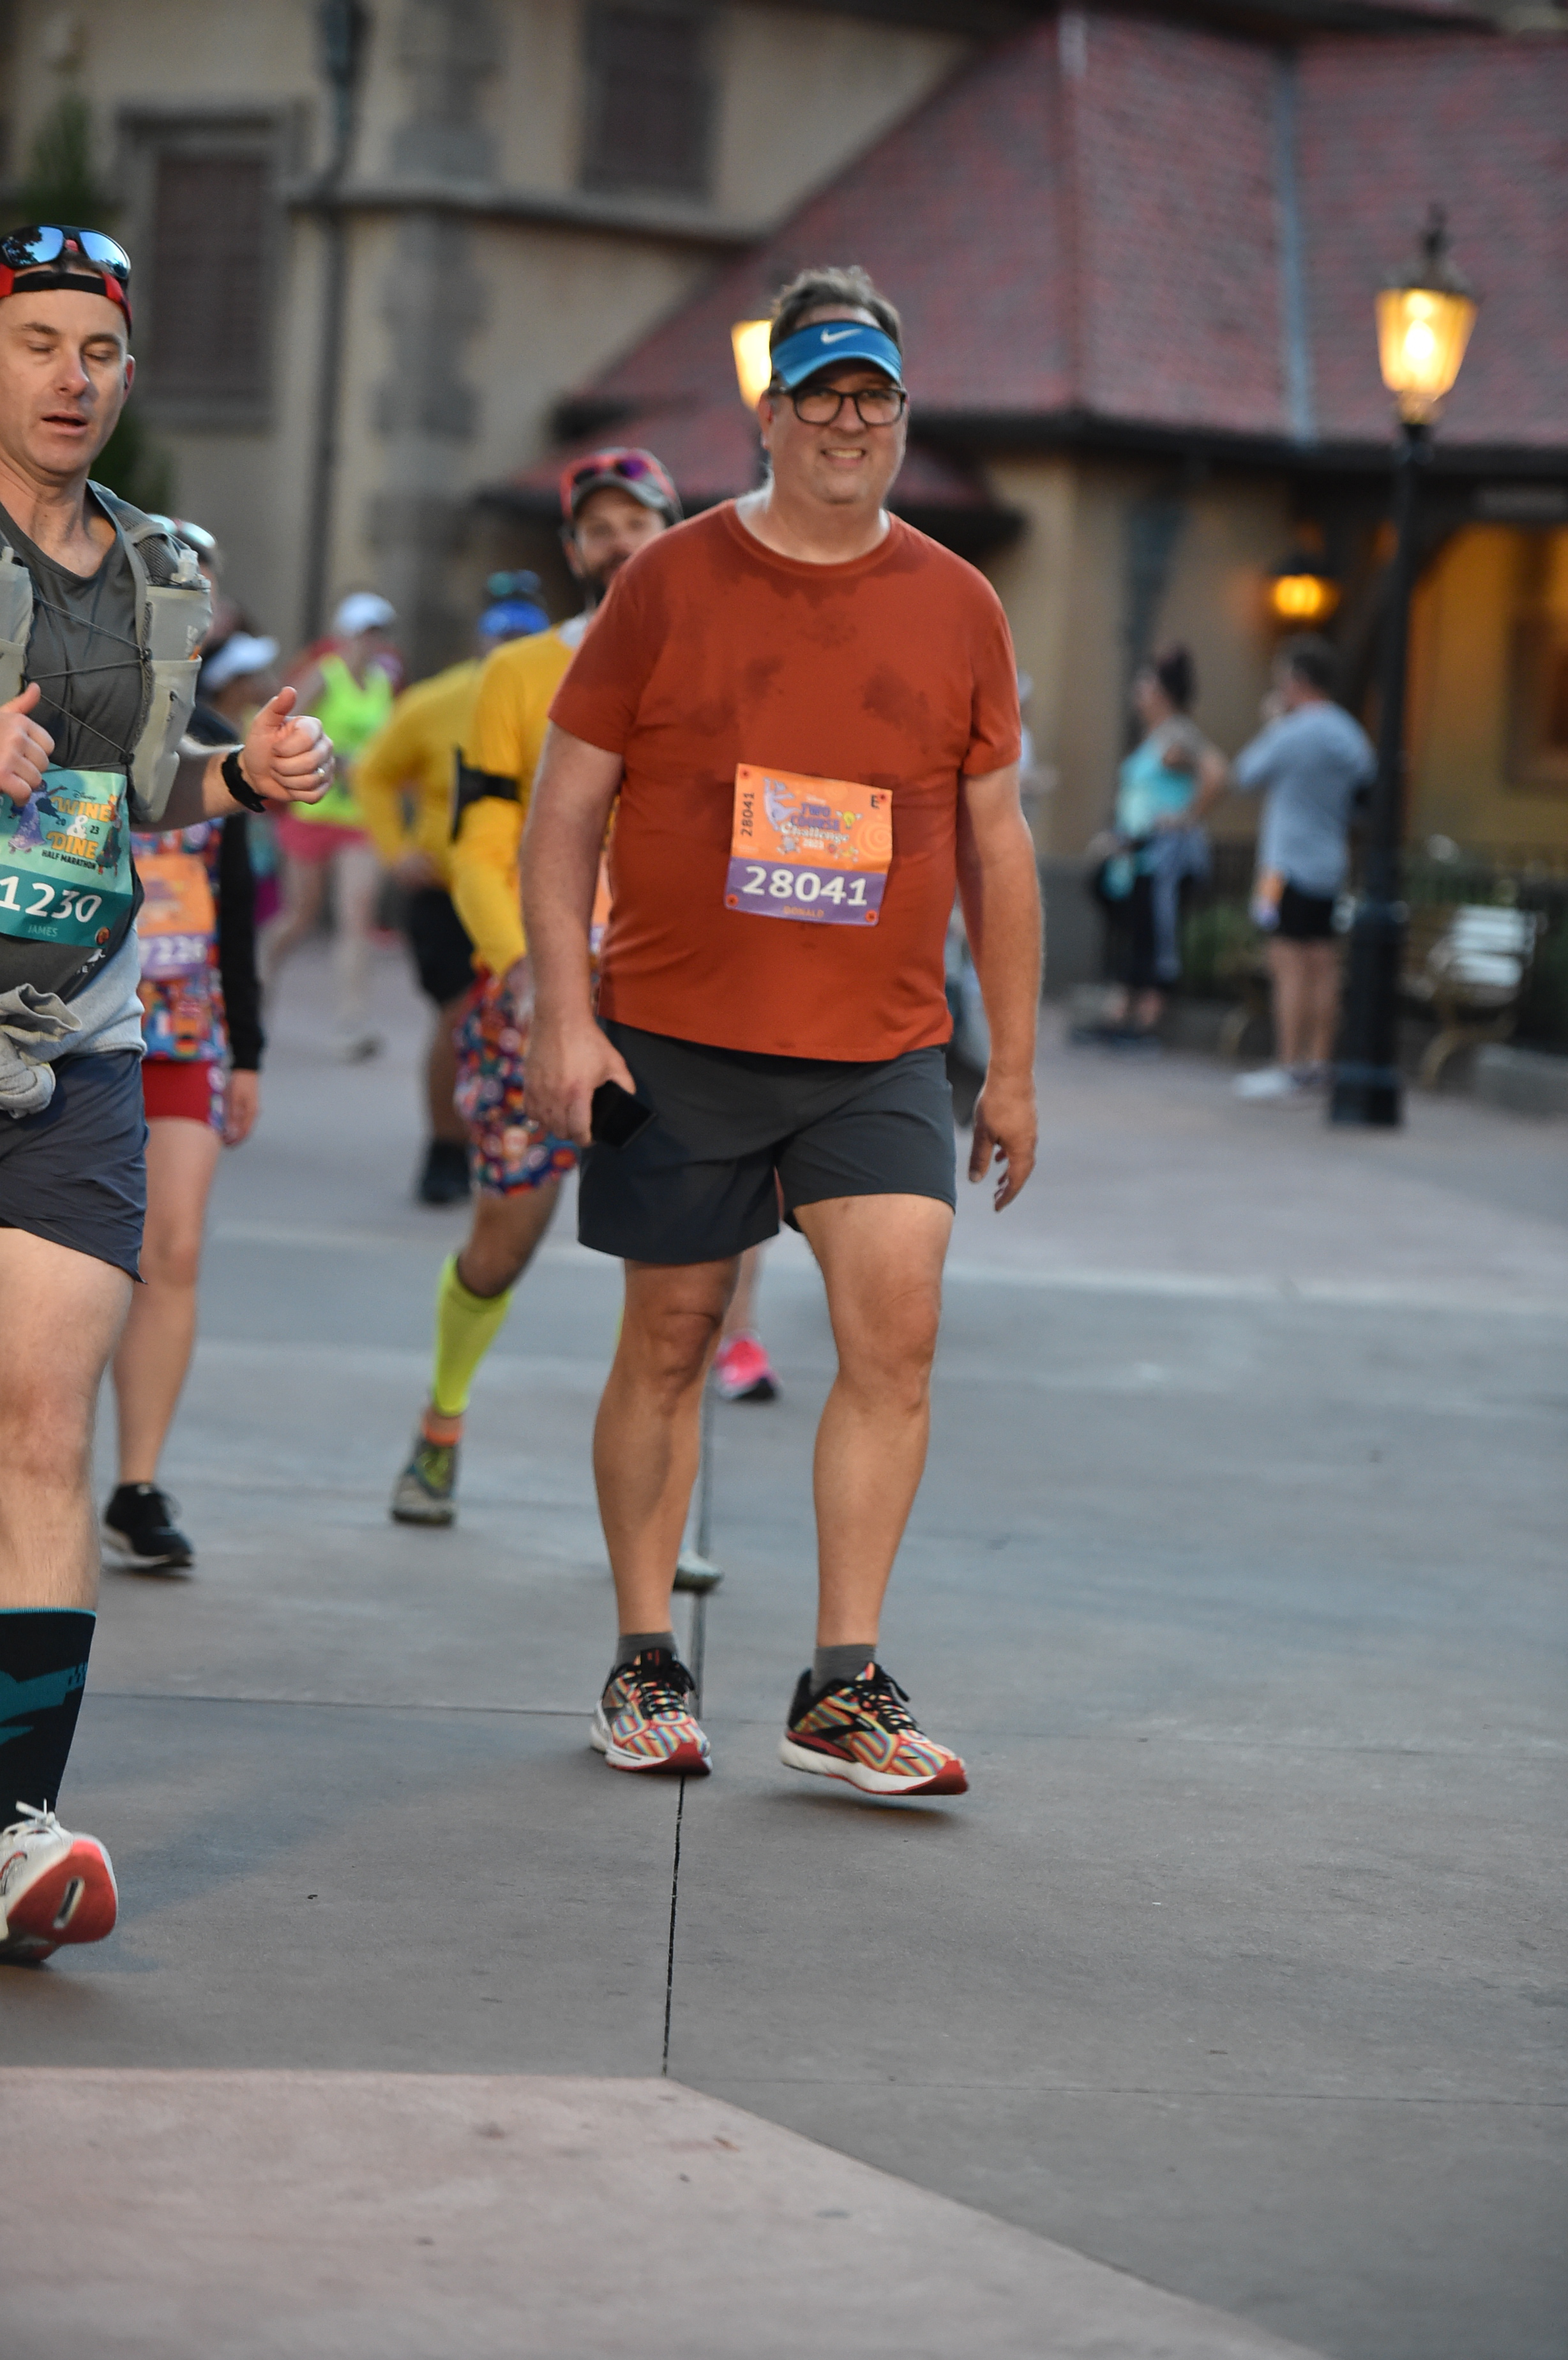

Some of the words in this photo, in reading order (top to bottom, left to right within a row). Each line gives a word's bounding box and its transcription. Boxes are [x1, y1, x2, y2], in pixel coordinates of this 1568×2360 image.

[50, 796, 113, 822] WINE
[871, 794, 880, 809] E
[56, 818, 66, 826] 20
[66, 814, 89, 839] &
[741, 792, 755, 837] 28041
[89, 825, 100, 835] 23
[780, 822, 850, 845] Challenge
[46, 831, 99, 860] DINE
[41, 849, 60, 861] HALF
[60, 854, 96, 870] MARATHON
[741, 865, 868, 906] 28041
[0, 875, 103, 923] 1230
[28, 925, 58, 937] JAMES
